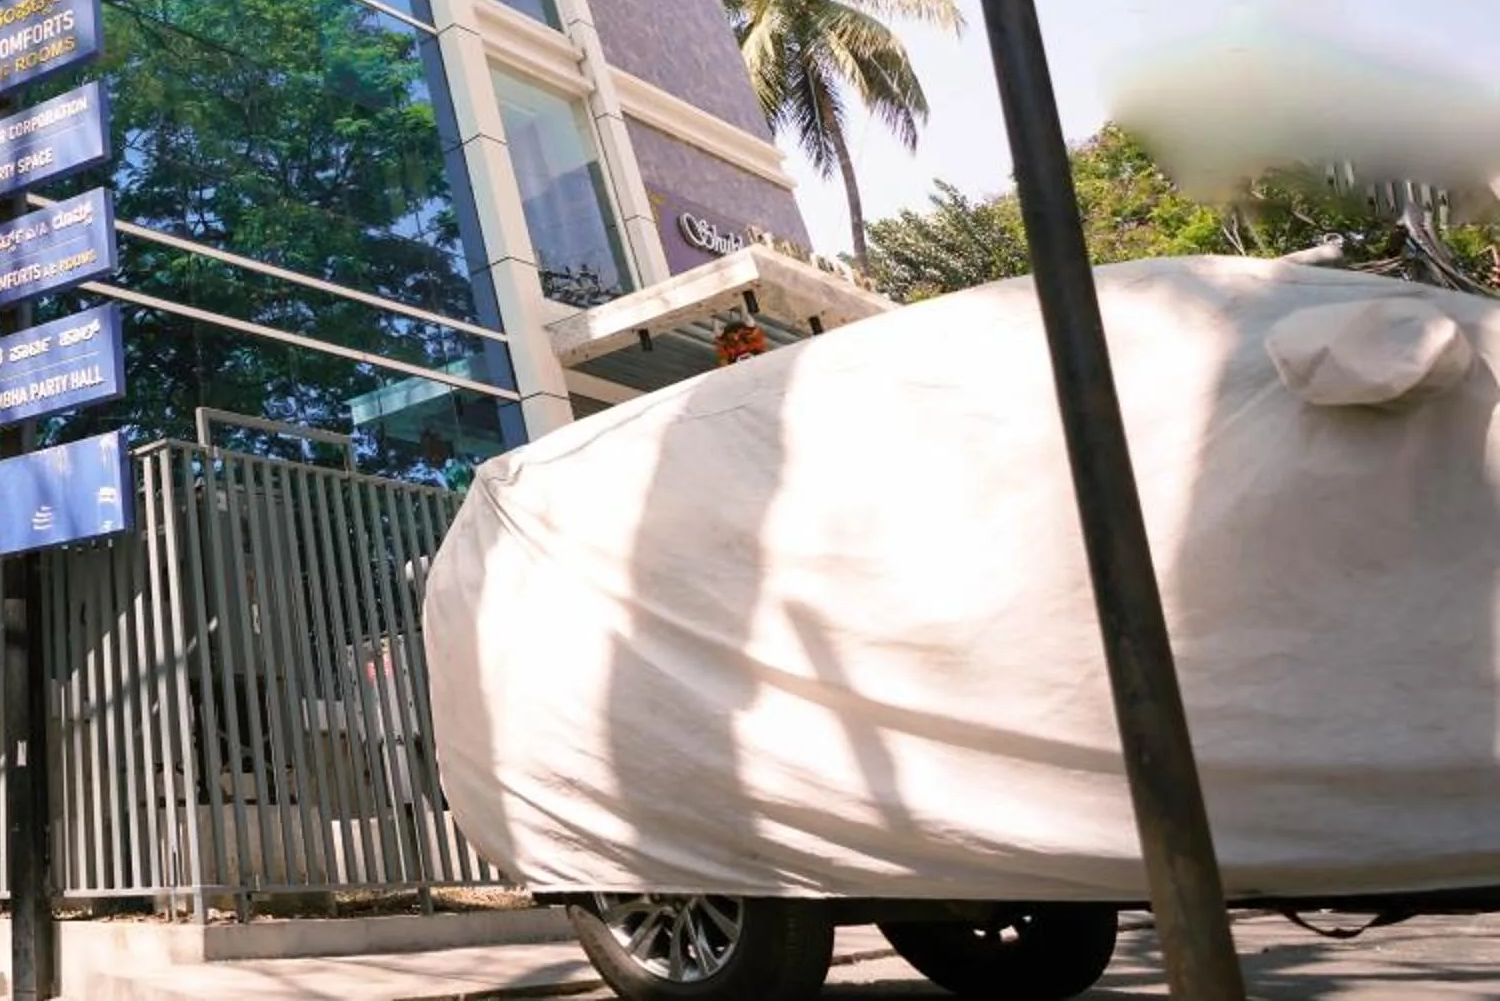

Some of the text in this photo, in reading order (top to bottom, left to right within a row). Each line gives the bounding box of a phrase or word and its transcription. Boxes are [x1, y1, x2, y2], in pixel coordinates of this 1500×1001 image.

[14, 37, 76, 72] ROOMS
[8, 96, 88, 141] CORPORATION
[17, 147, 53, 174] SPACE
[30, 373, 68, 401] PARTY
[71, 364, 103, 390] HALL
